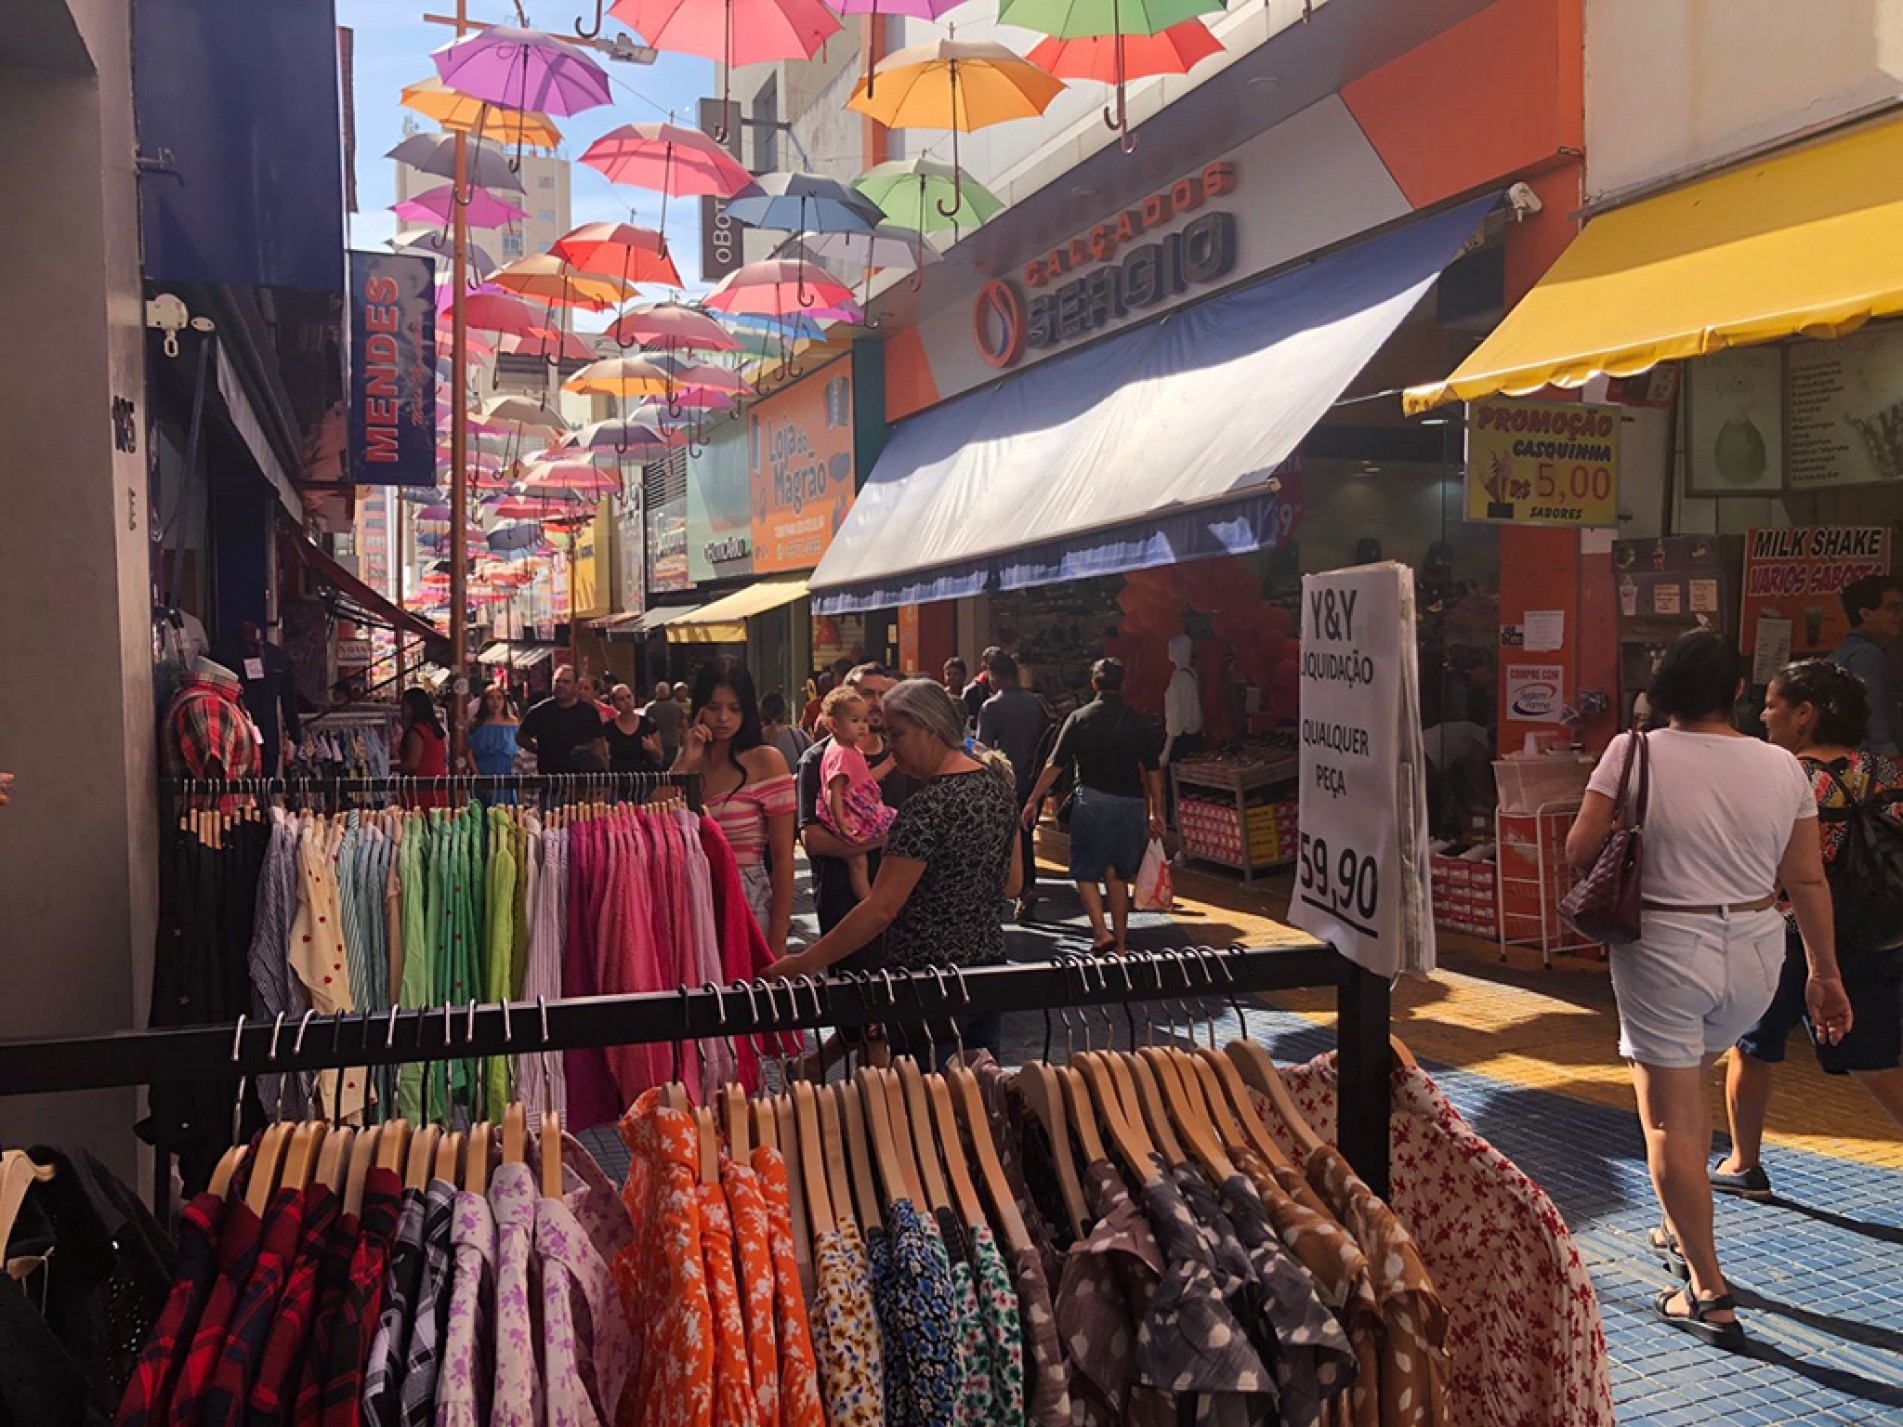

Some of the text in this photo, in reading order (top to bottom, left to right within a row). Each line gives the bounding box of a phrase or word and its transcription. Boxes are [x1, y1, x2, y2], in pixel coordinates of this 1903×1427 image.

[365, 276, 399, 463] MENDES
[767, 413, 796, 470] Loja
[1477, 406, 1613, 441] PROMOÇÃO
[1512, 439, 1612, 462] CASQUINHA
[773, 450, 827, 516] Magrão
[1538, 463, 1611, 504] 5,00
[1529, 506, 1583, 520] SABORES
[1754, 528, 1883, 558] MILK SHAKE
[1310, 588, 1357, 641] Y&Y
[1303, 718, 1369, 756] QUALQUER
[1315, 763, 1346, 798] PEÇA
[1300, 832, 1378, 919] 59,90
